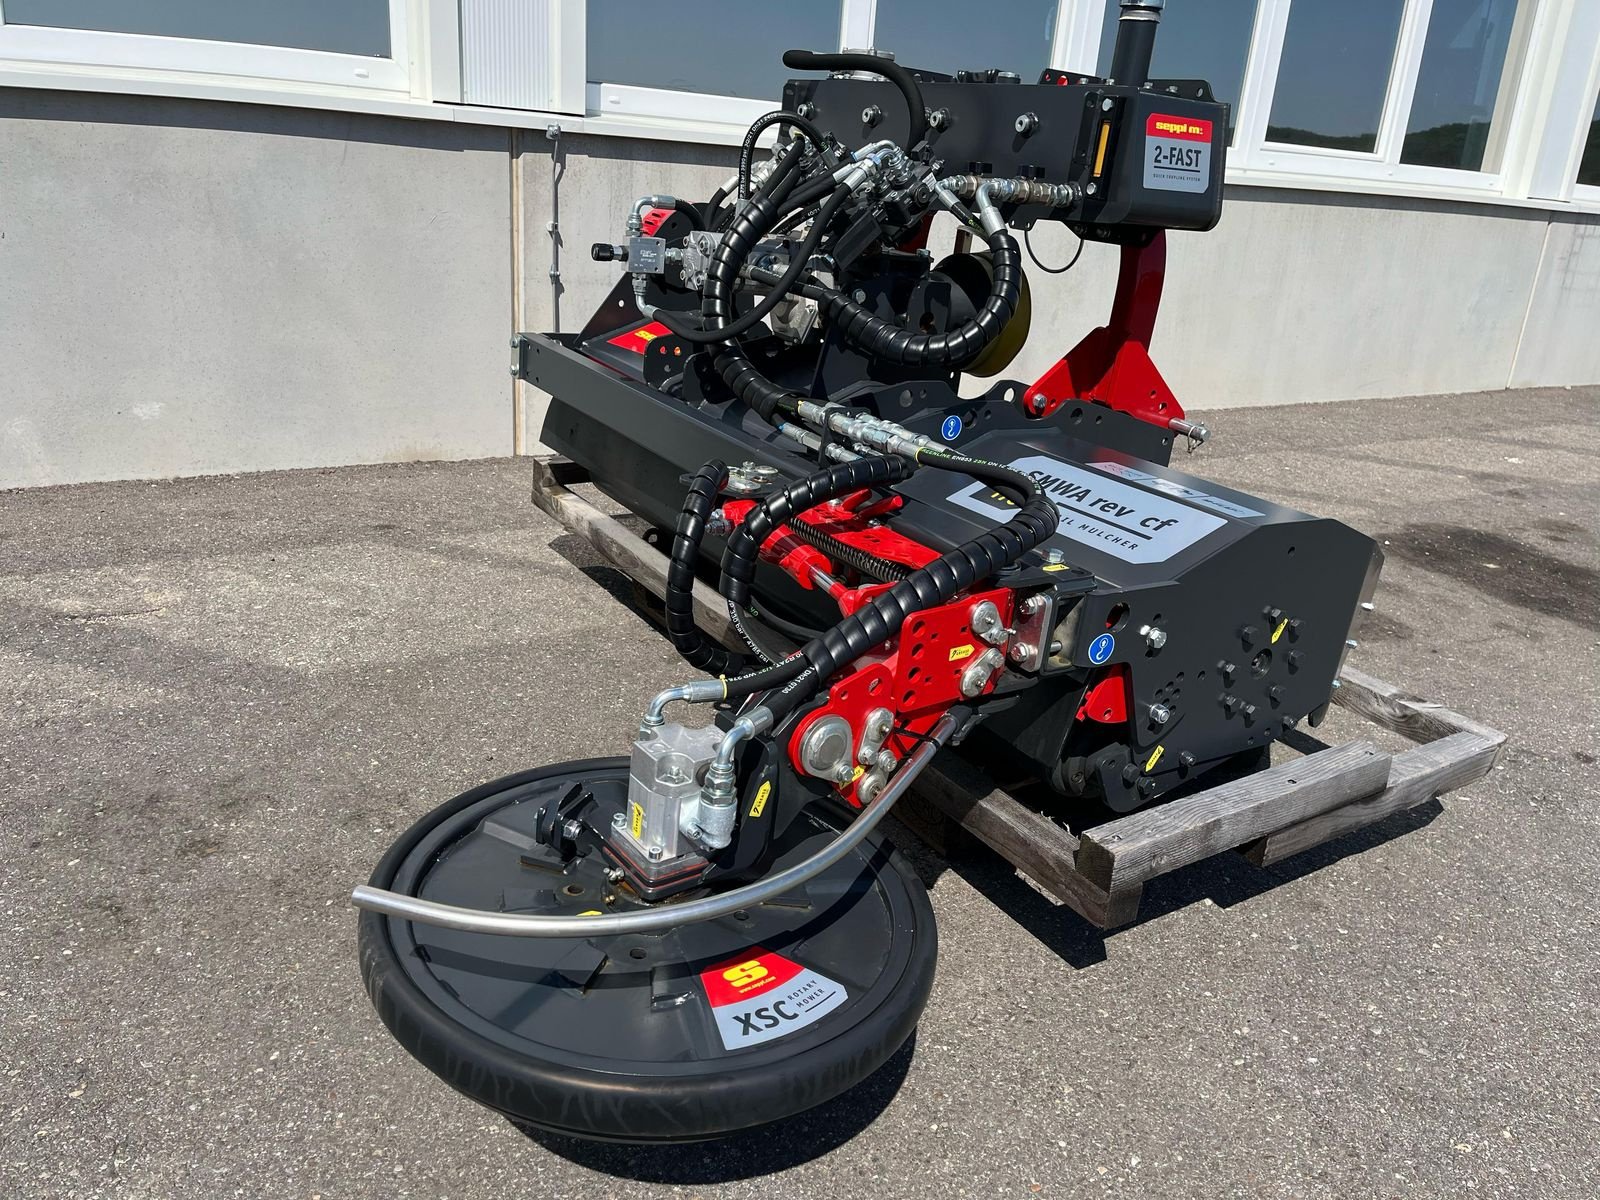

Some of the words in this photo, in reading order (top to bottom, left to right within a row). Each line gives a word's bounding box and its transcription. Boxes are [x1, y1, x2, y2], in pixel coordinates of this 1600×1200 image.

[1155, 121, 1187, 134] seppi
[1153, 145, 1202, 168] 2-FAST
[1029, 470, 1092, 503] SMWA
[1089, 497, 1136, 518] rev
[1139, 516, 1179, 532] cf
[1078, 523, 1139, 551] MULCHER
[787, 979, 818, 1001] ROTARY
[796, 988, 826, 1008] MOWER
[732, 1001, 800, 1036] XSC
